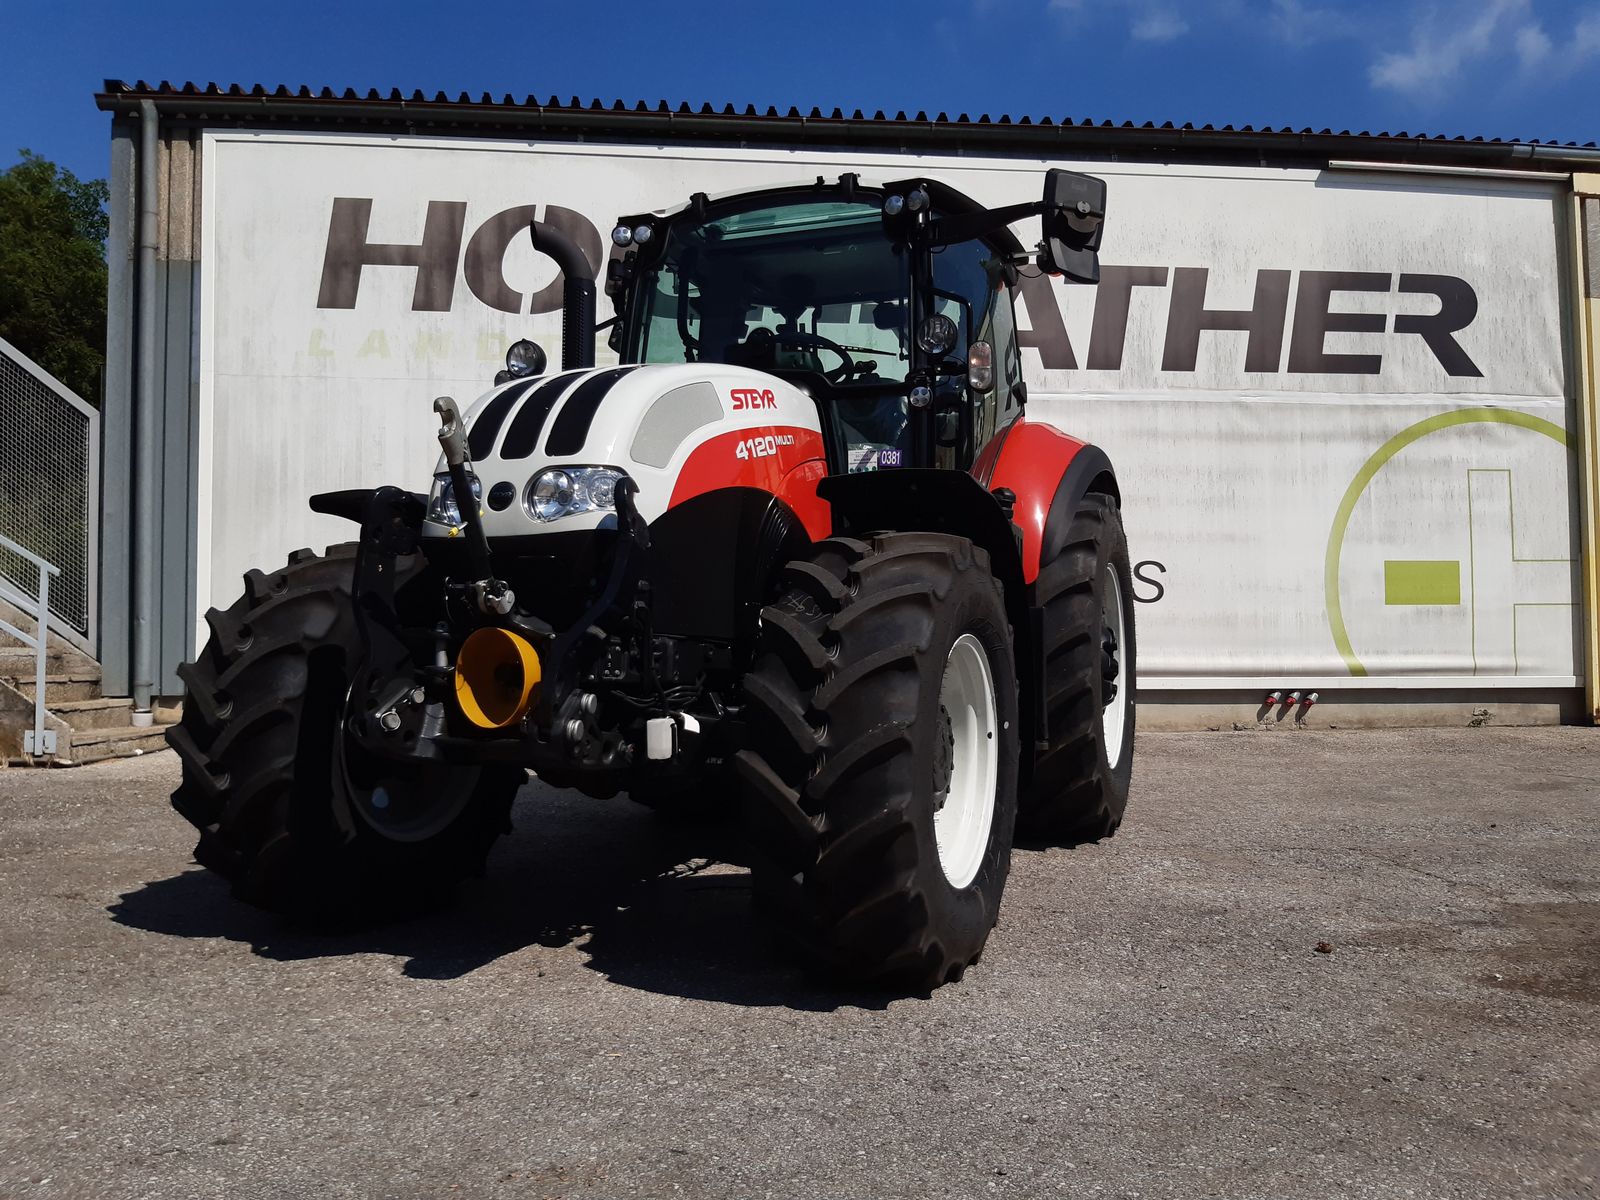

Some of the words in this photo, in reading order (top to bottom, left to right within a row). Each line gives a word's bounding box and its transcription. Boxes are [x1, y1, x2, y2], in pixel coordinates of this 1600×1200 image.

[730, 388, 778, 410] STEYR
[735, 436, 777, 460] 4120
[775, 434, 795, 446] MULTI
[881, 451, 901, 465] 0381
